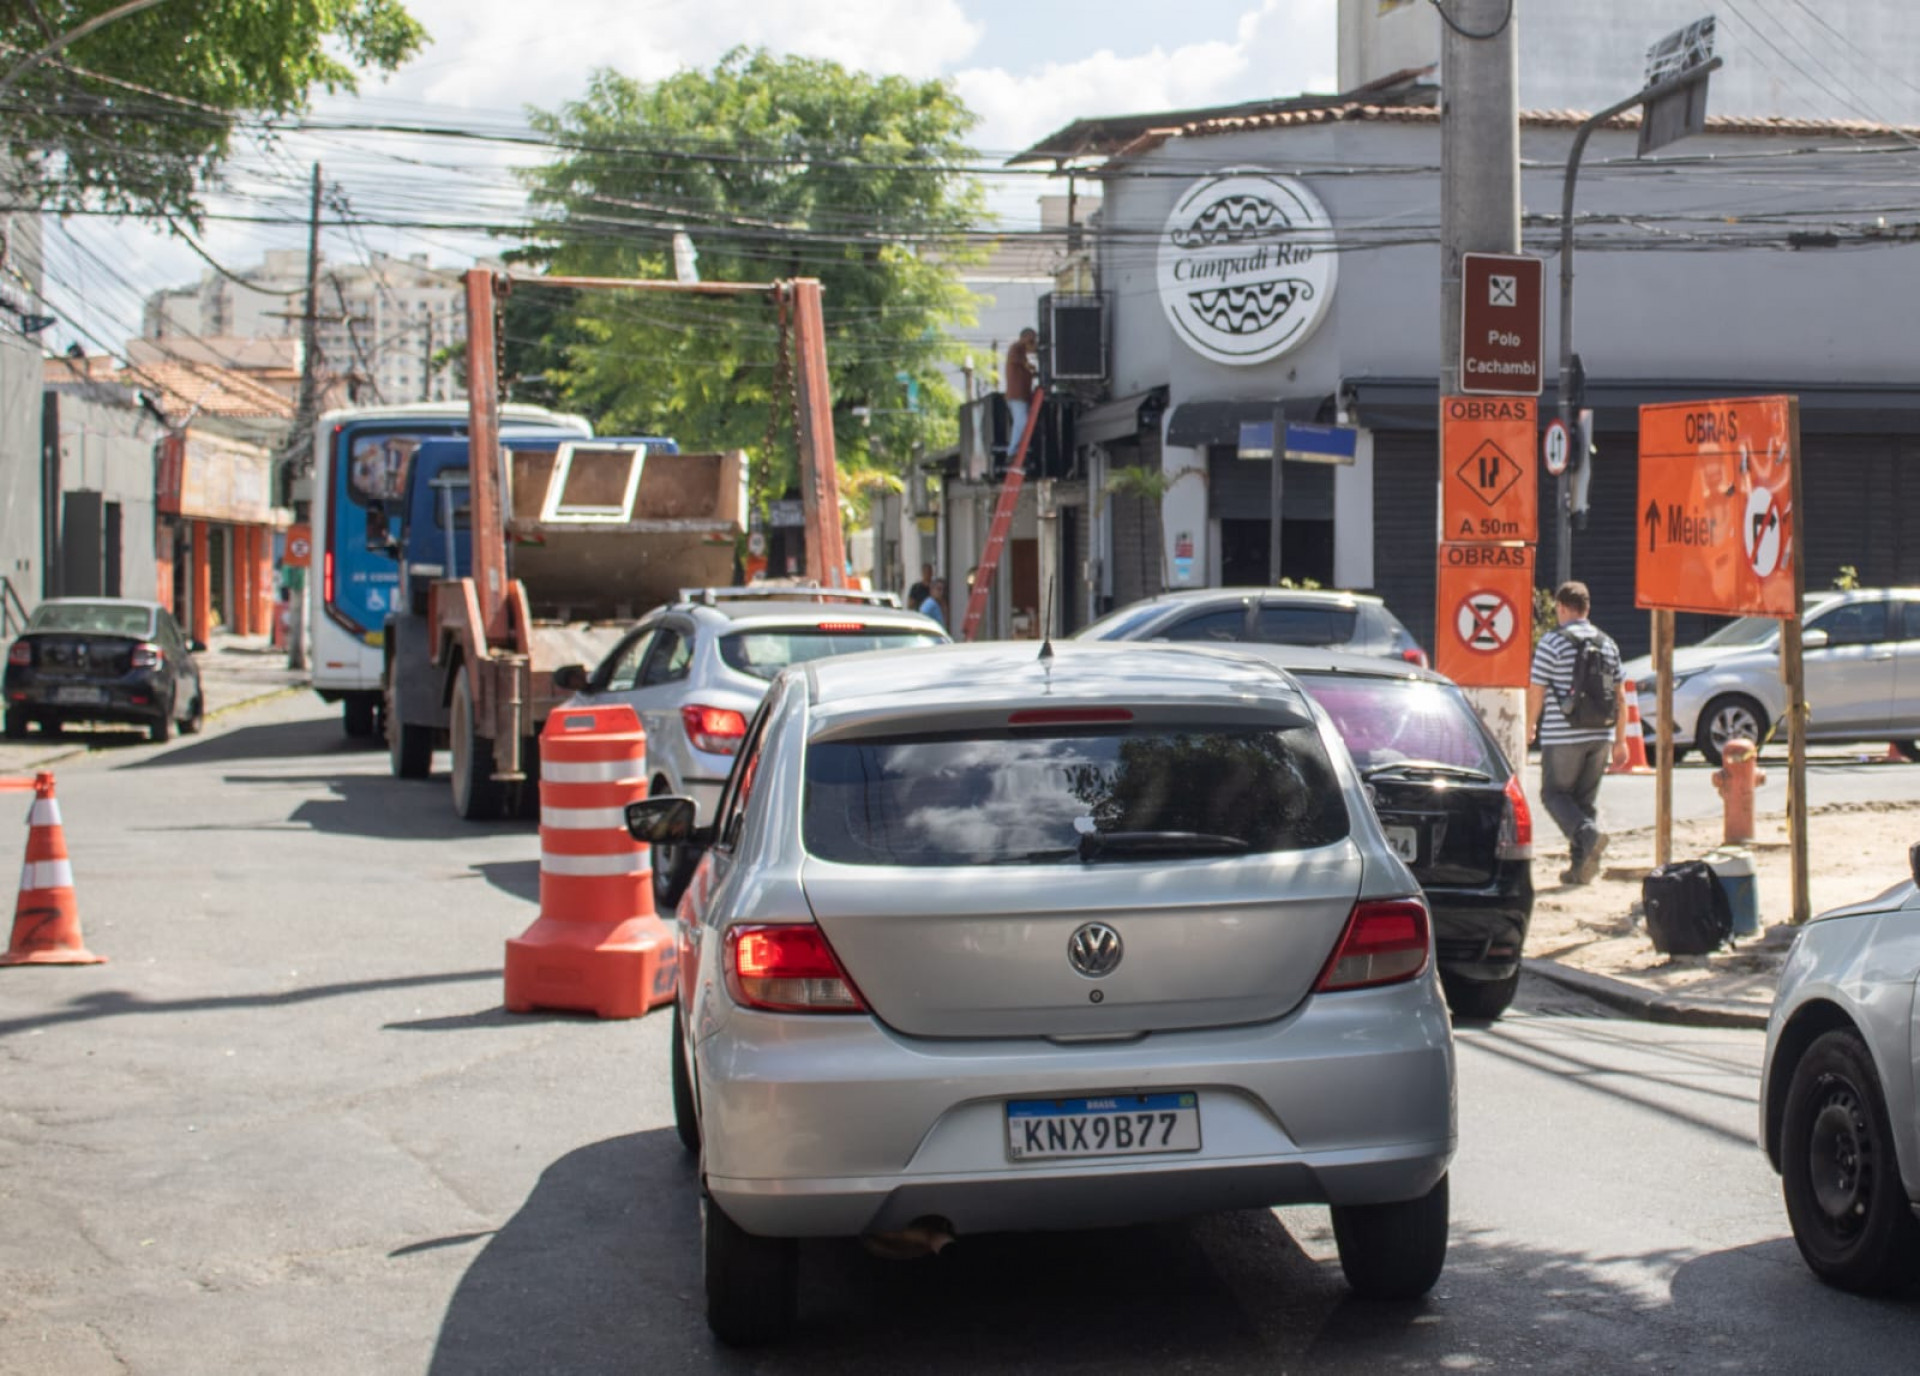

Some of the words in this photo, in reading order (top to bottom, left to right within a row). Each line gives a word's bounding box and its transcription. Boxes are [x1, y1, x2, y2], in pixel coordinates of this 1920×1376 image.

[1174, 245, 1269, 282] Cumpadi
[1276, 241, 1314, 268] Rio
[1487, 330, 1521, 348] Polo
[1466, 357, 1537, 375] Cachambi
[1450, 402, 1527, 420] OBRAS
[1685, 411, 1738, 443] OBRAS
[1459, 520, 1474, 535] A
[1480, 519, 1519, 535] 50m
[1667, 504, 1716, 546] Meier
[1447, 548, 1526, 566] OBRAS
[1025, 1114, 1177, 1152] KNX9B77
